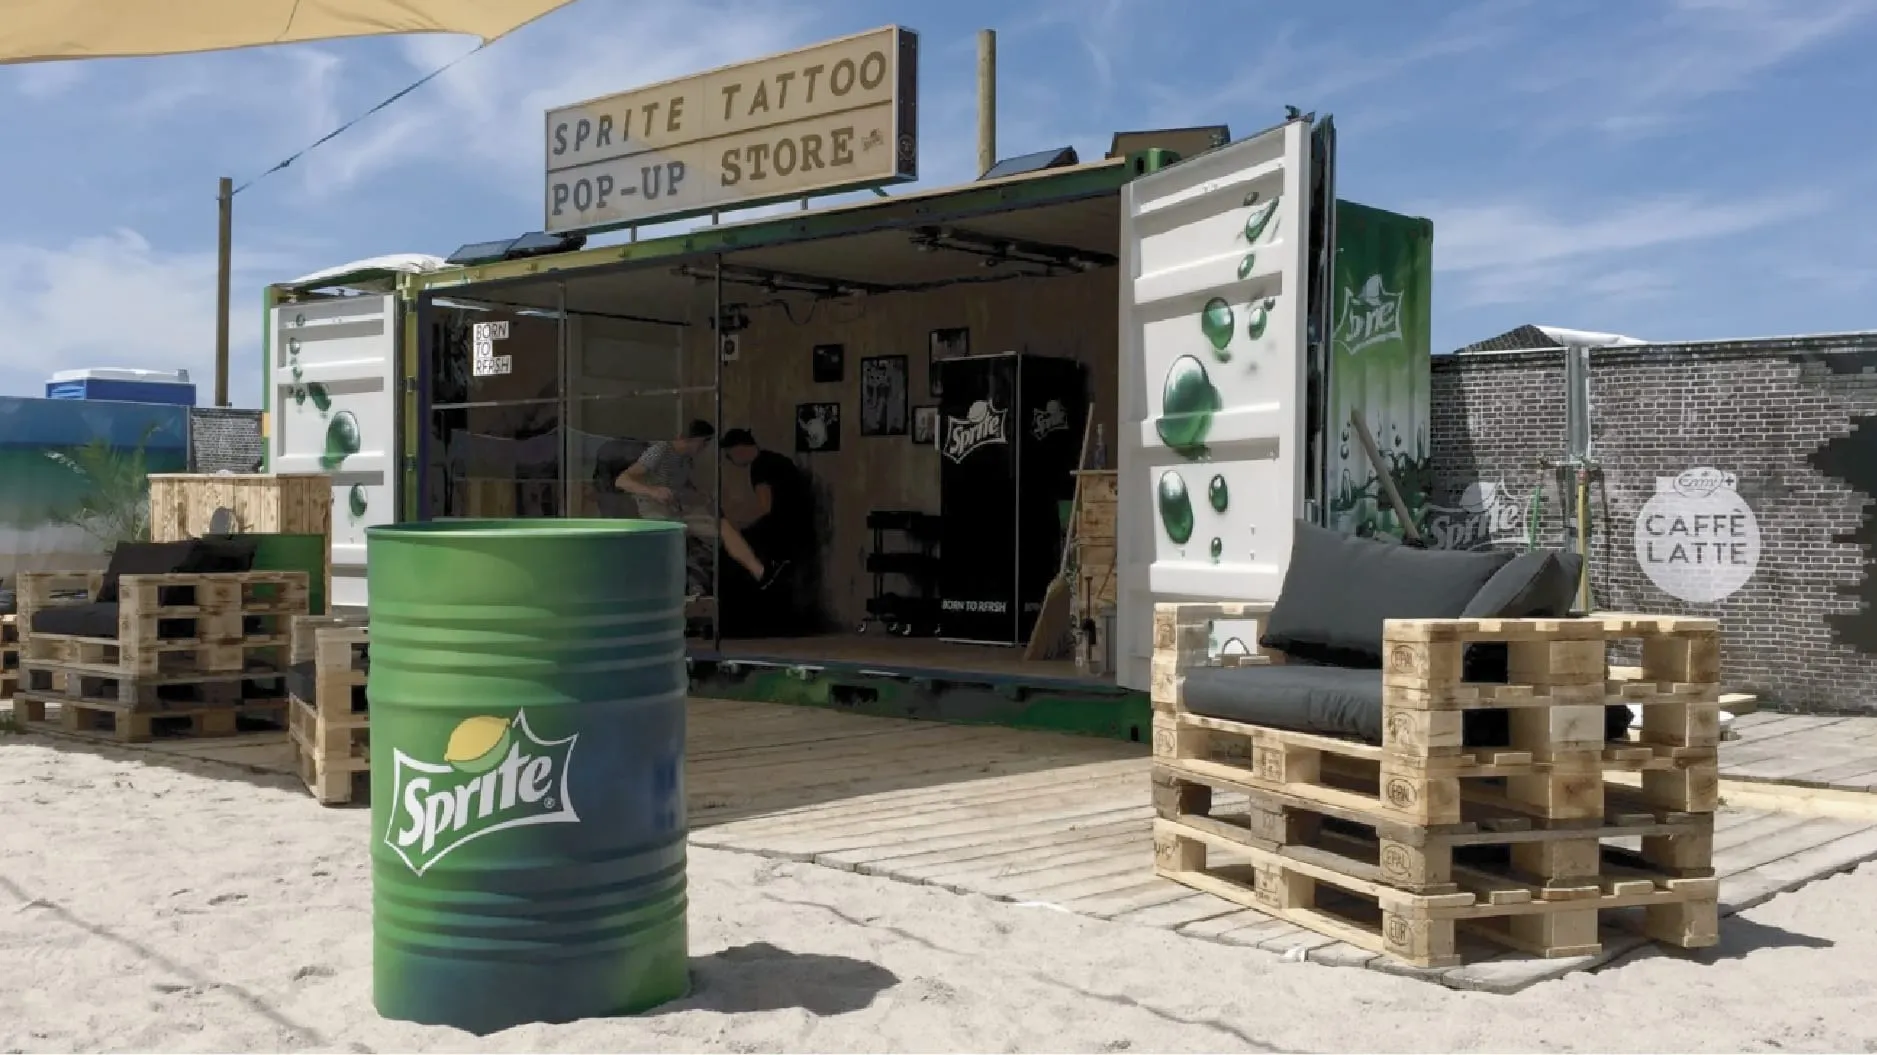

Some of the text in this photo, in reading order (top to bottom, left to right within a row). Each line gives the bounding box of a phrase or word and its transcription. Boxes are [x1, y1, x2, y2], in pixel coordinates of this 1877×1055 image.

[553, 51, 887, 156] SPRITE TATTOO
[552, 160, 686, 216] POP-UP
[721, 126, 854, 187] STORE
[476, 322, 507, 340] BORN
[476, 341, 490, 358] TO
[950, 415, 1000, 455] Sprite
[1431, 497, 1519, 550] Sprite
[1647, 541, 1747, 565] LATTE
[942, 599, 965, 610] BORN
[966, 601, 978, 611] TO
[398, 740, 553, 855] Sprite
